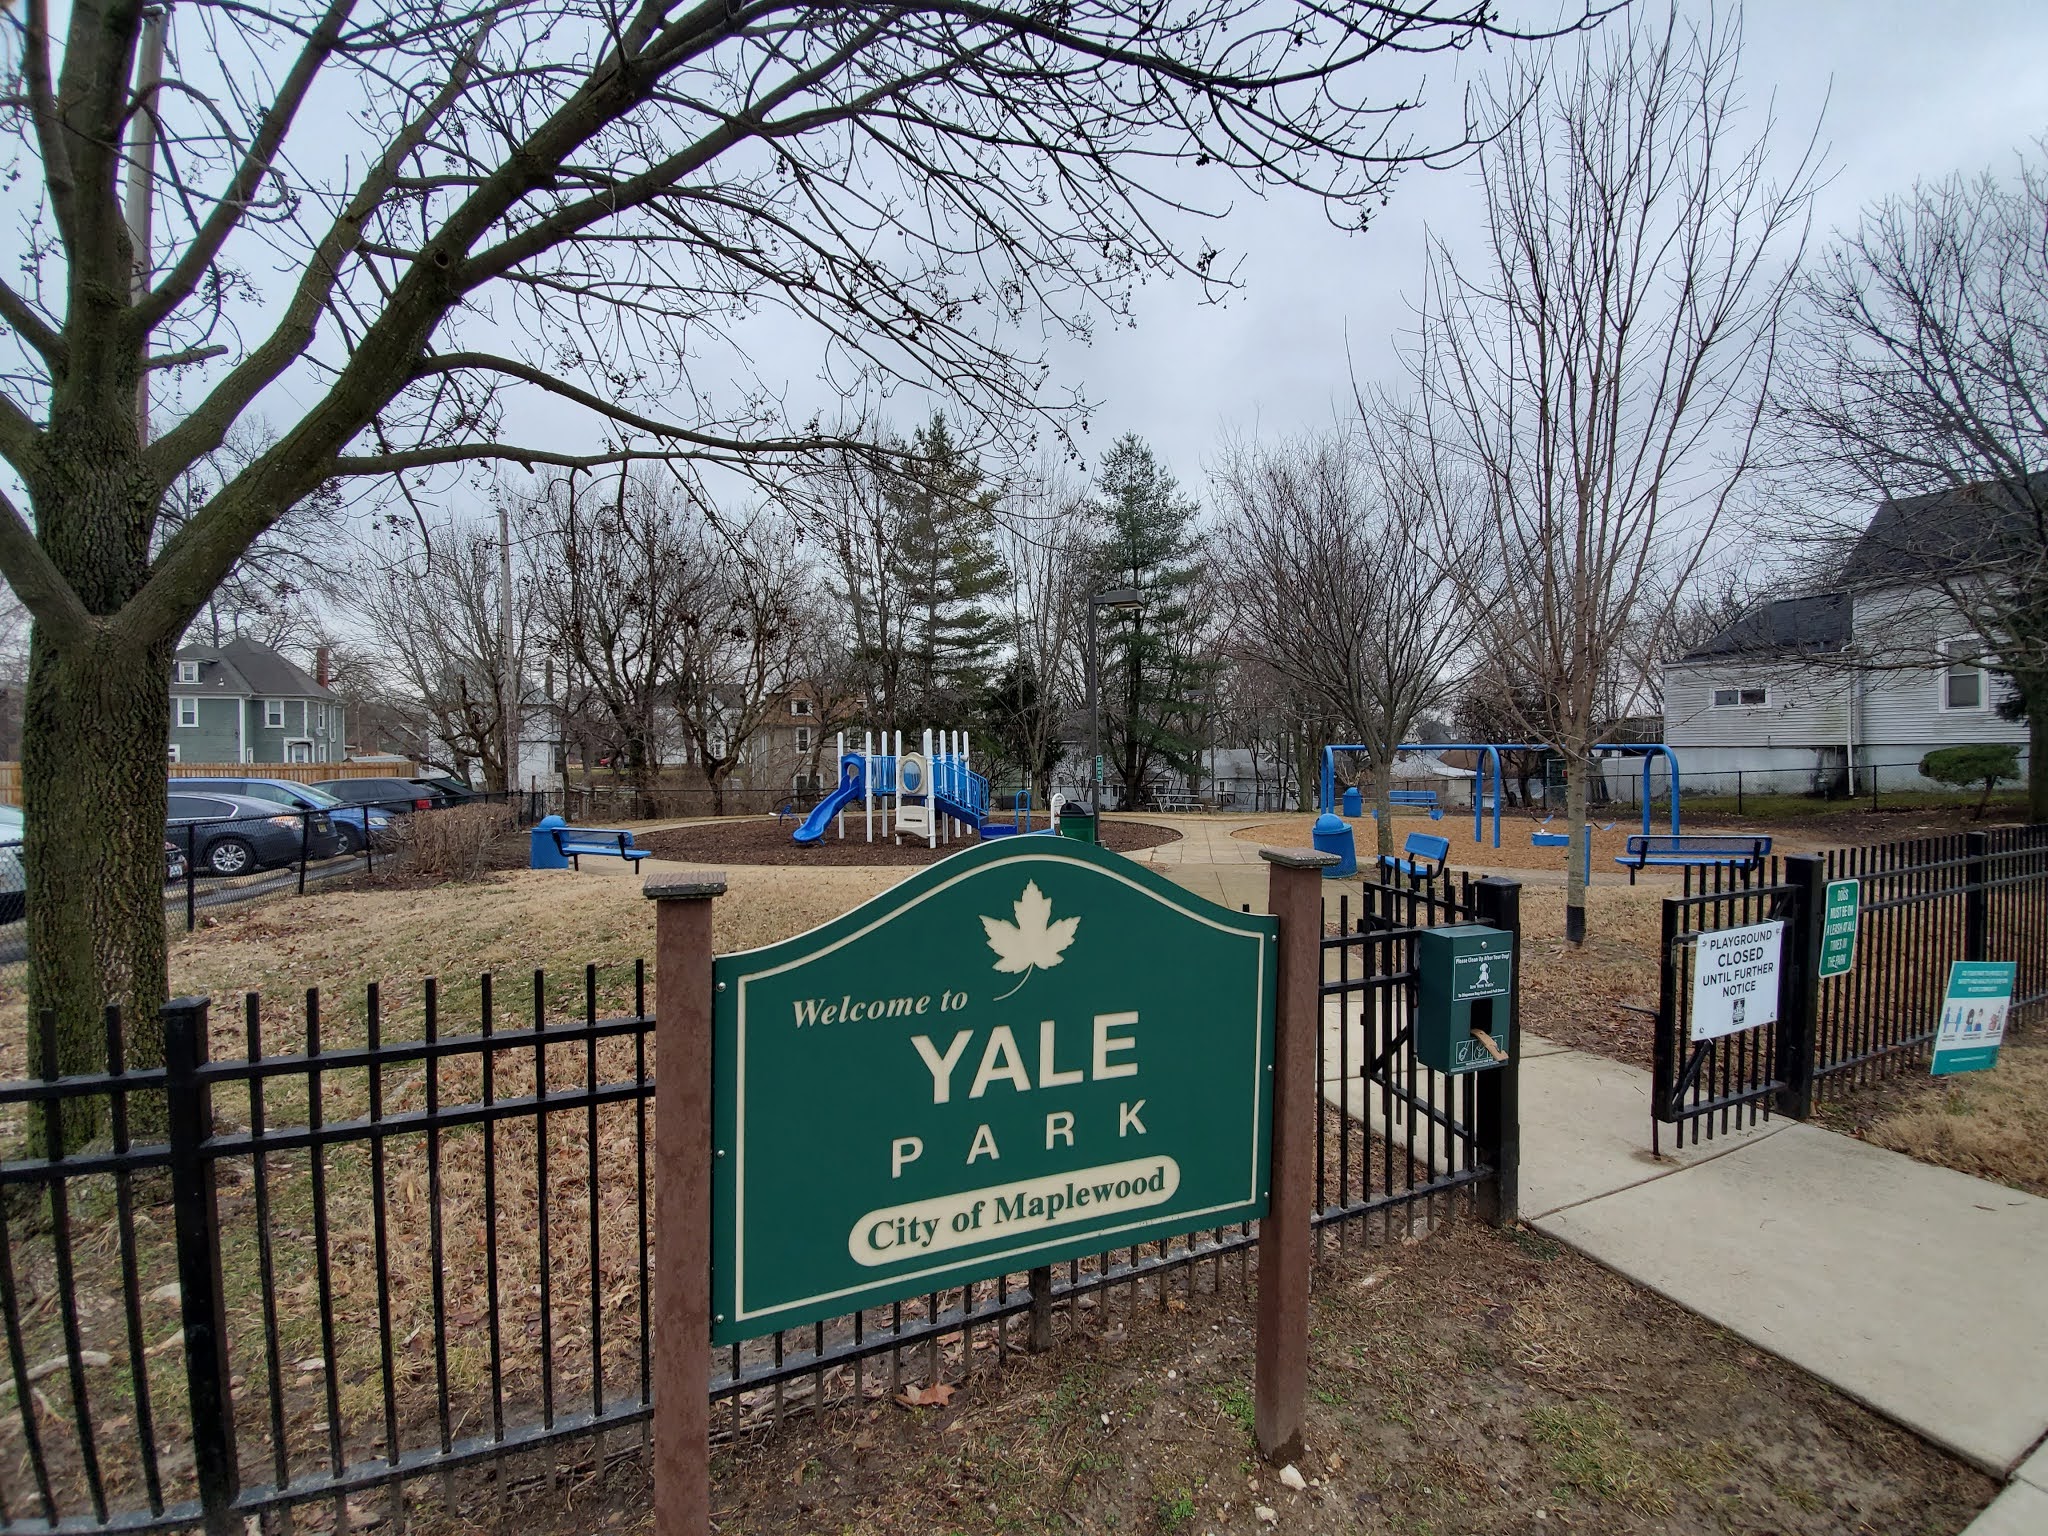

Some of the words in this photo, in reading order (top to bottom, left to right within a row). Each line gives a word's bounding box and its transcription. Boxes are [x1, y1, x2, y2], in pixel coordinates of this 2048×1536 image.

[1710, 930, 1772, 950] PLAYGROUND
[1717, 946, 1764, 968] CLOSED
[1702, 972, 1732, 986] UNTIL
[1734, 962, 1774, 980] FURTHER
[1722, 980, 1756, 998] NOTICE
[793, 994, 929, 1029] Welcome
[940, 989, 969, 1012] to
[909, 1010, 1140, 1105] YALE
[890, 1099, 1149, 1179] PARK
[867, 1218, 941, 1253] City
[951, 1200, 987, 1234] of
[994, 1166, 1167, 1222] Maplewood
